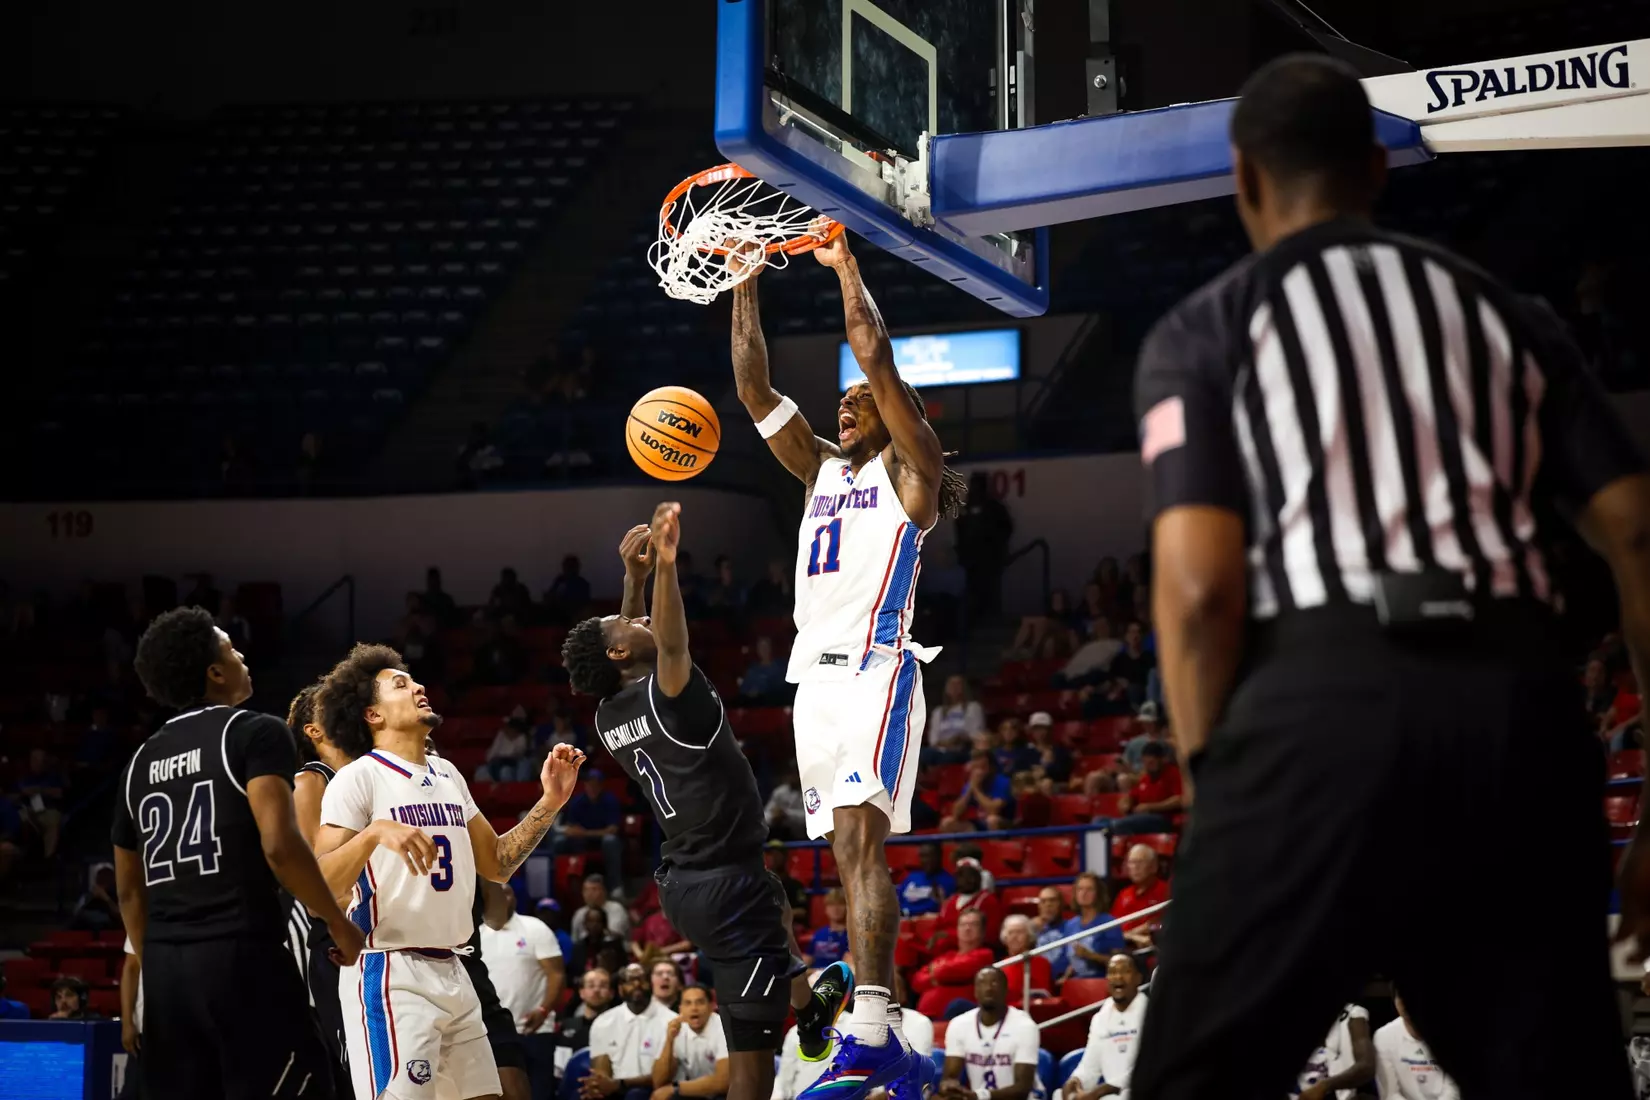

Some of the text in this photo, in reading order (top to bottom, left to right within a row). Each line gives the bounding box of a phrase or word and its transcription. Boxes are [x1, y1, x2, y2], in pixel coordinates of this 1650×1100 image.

[1426, 45, 1630, 113] SPALDING
[657, 409, 704, 438] NCAA
[640, 431, 698, 468] Wilson
[846, 486, 879, 508] TECH
[46, 510, 93, 538] 119
[807, 518, 842, 577] 11
[603, 714, 652, 751] MCMILLIAN
[149, 748, 202, 785] RUFFIN
[633, 747, 676, 819] 1
[138, 779, 223, 887] 24
[431, 834, 453, 892] 3
